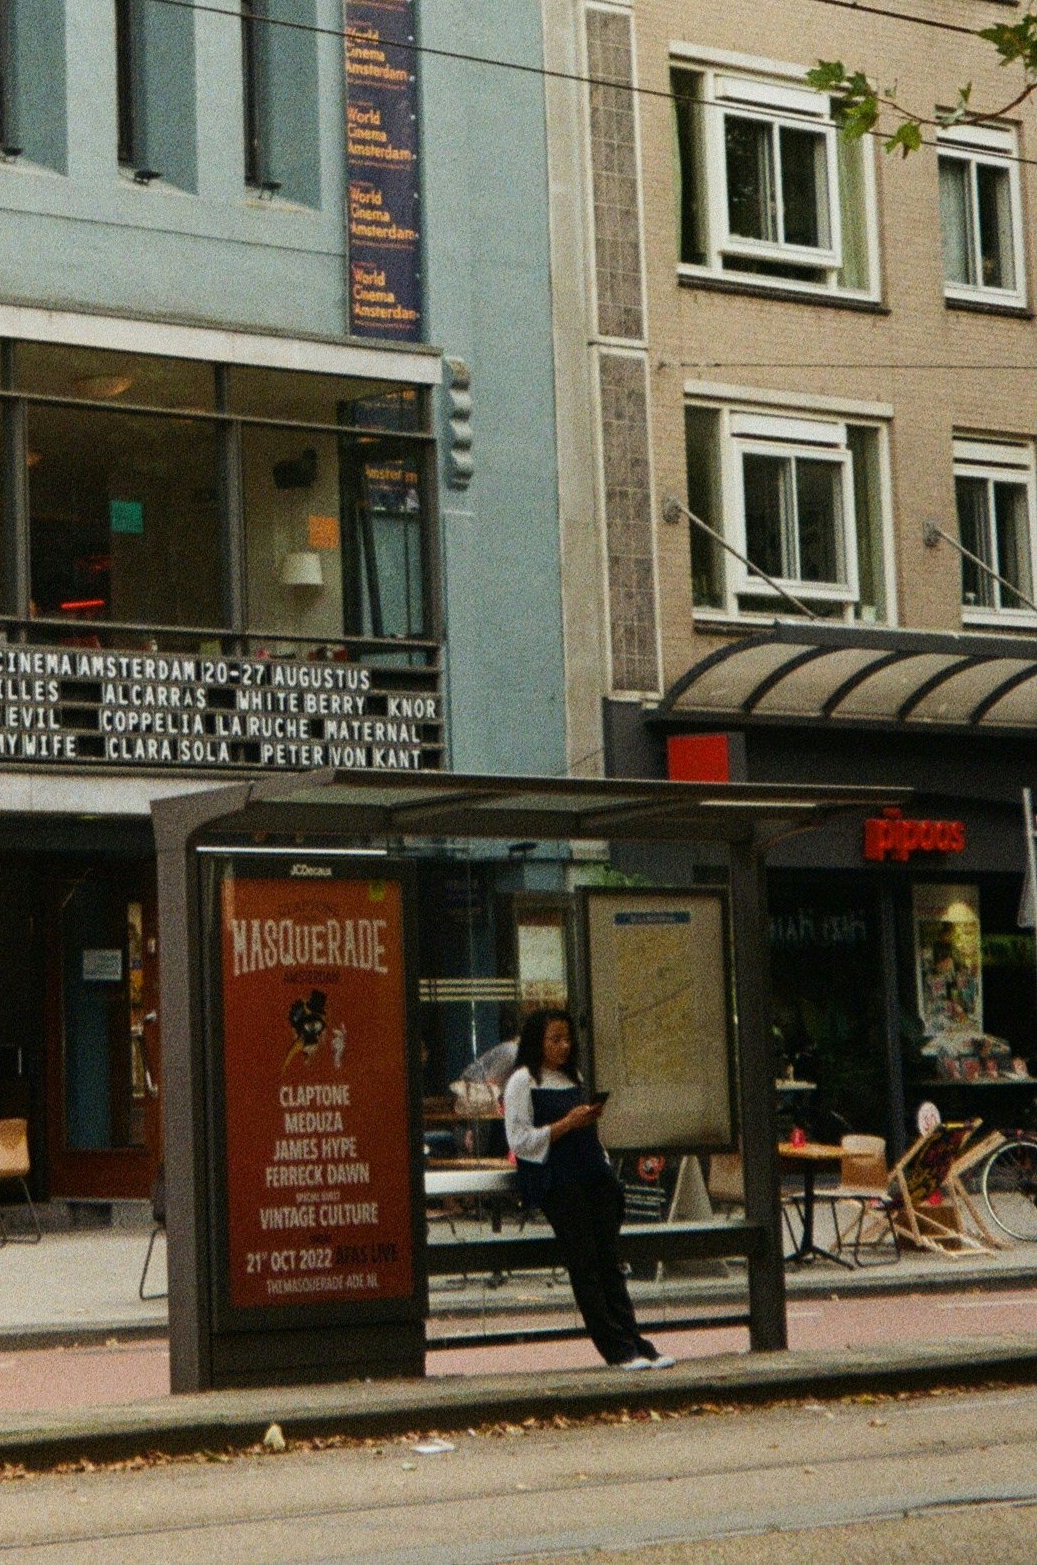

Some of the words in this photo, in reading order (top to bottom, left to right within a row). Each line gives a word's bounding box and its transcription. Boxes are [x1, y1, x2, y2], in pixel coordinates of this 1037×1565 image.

[346, 60, 408, 81] Amsterdam
[347, 106, 381, 125] World
[347, 122, 387, 142] Cinema
[347, 140, 411, 161] Amsterdam
[349, 185, 382, 205] World
[350, 202, 390, 222] Cinema
[351, 221, 415, 239] Amsterdam
[352, 266, 386, 286] World
[352, 284, 395, 303] Cinema
[353, 302, 416, 320] Amsterdam
[79, 655, 195, 681] AMSTERDAM
[205, 661, 264, 685] 20-27
[274, 666, 370, 690] AUGUSTUS
[105, 685, 206, 709] ALCARRAS
[389, 698, 436, 718] KNOR
[9, 706, 60, 729] EVIL
[102, 711, 203, 734] COPPELIA
[218, 715, 242, 736] LA
[249, 717, 309, 739] RUCHE
[325, 720, 420, 743] MATERNAL
[24, 735, 76, 757] WIFE
[109, 737, 171, 760] CLARA
[181, 740, 230, 762] SOLA
[263, 742, 323, 767] PETER
[330, 746, 366, 767] VON
[374, 748, 421, 770] KANT
[864, 807, 966, 862] pipoos
[290, 864, 332, 876] JCDecaux
[230, 918, 388, 976] MASQUERADE
[279, 1085, 350, 1107] CLAPTONE
[284, 1111, 343, 1133] MEDUZA
[274, 1138, 318, 1161] JAMES
[322, 1137, 357, 1159] HYPE
[266, 1165, 323, 1188] FERRECK
[327, 1163, 369, 1185] DAWN
[260, 1205, 316, 1229] VINTAGE
[320, 1202, 378, 1226] CULTURE
[270, 1250, 296, 1271] OCT
[299, 1248, 332, 1269] 2022
